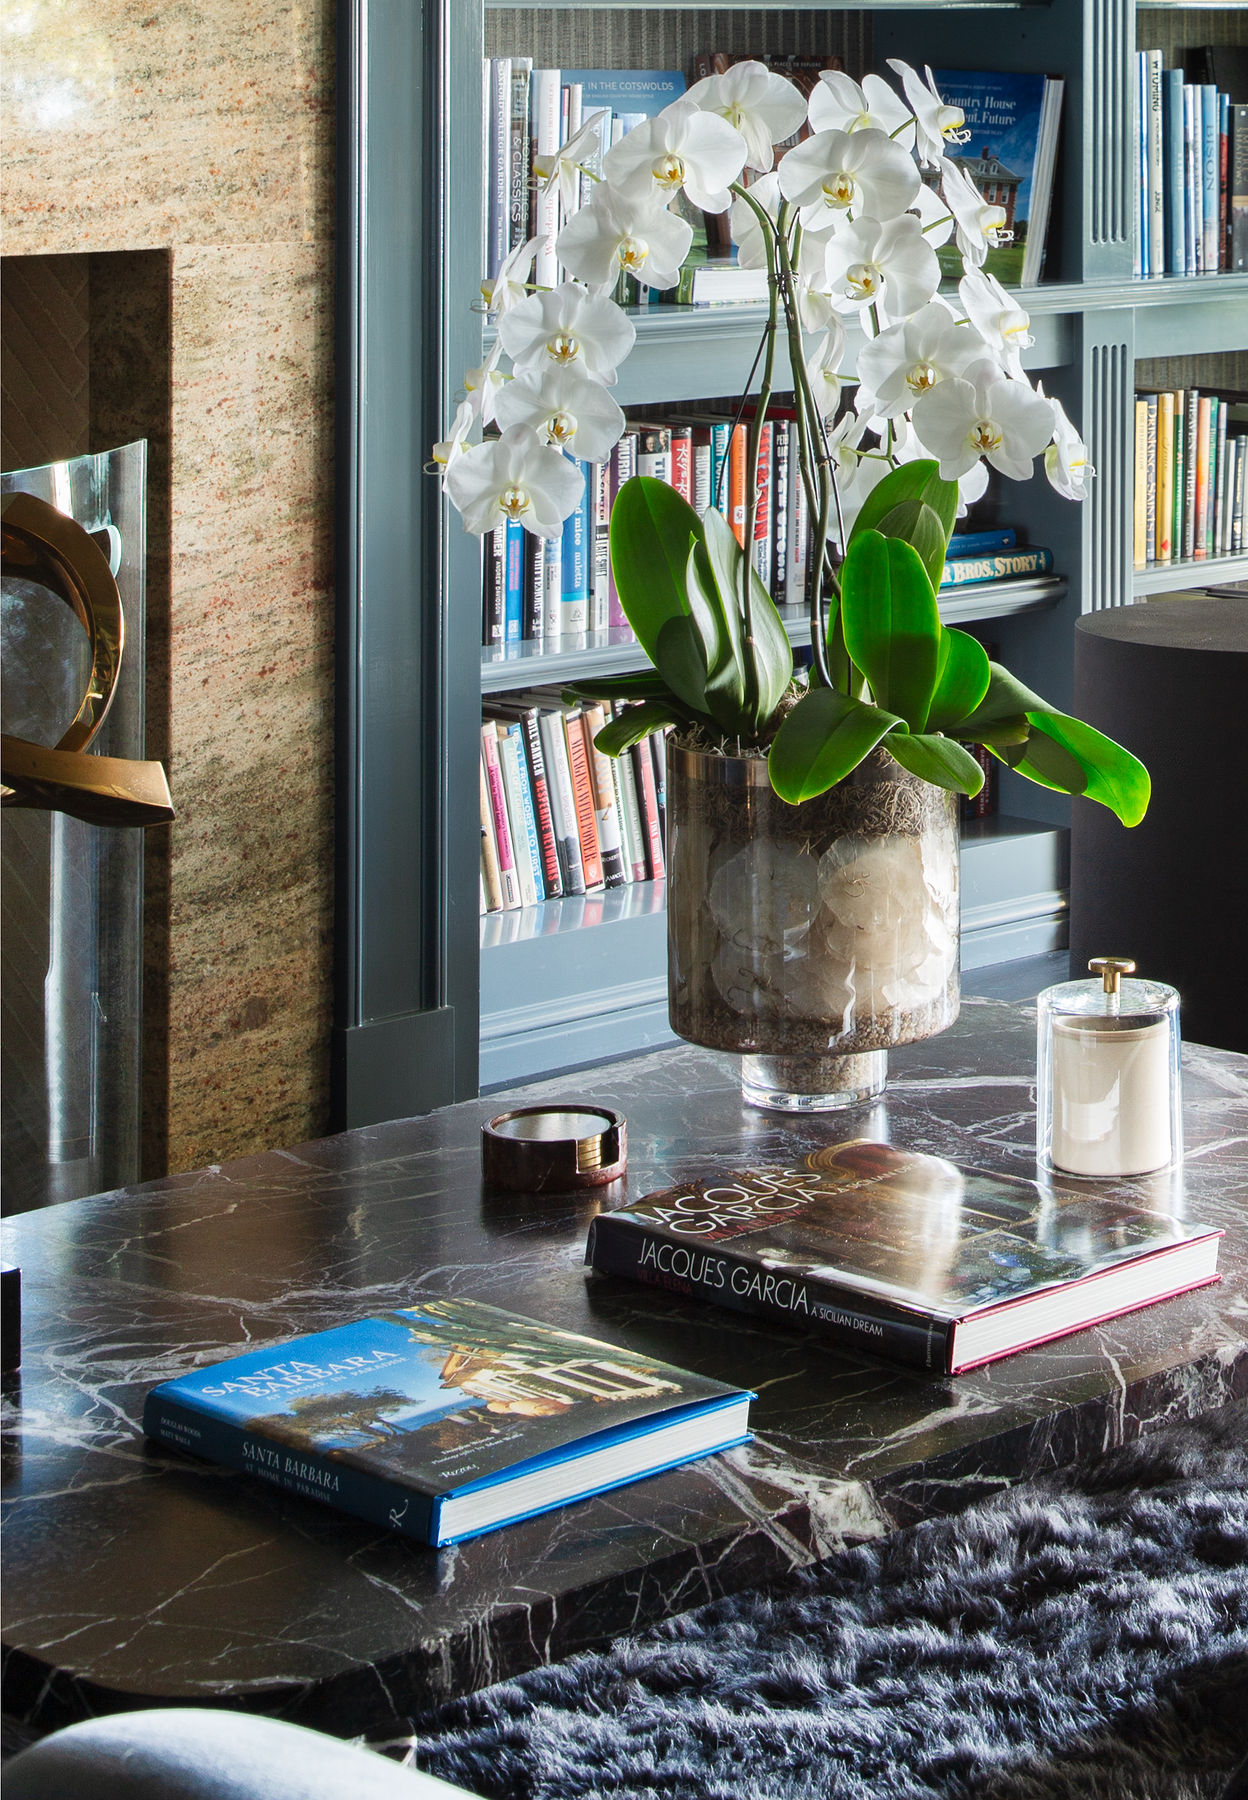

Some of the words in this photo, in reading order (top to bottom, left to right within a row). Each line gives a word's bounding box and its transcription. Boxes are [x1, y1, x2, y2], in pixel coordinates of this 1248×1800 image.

[497, 70, 505, 109] OXFORD
[588, 81, 597, 91] IN
[600, 81, 617, 91] THE
[618, 81, 674, 92] COTSWOLDS
[941, 93, 983, 112] Country
[984, 96, 1017, 110] House
[1151, 60, 1160, 112] WYOMING
[497, 111, 505, 154] COLLEGE
[982, 112, 1017, 126] Future
[1206, 125, 1215, 192] BISON
[1235, 126, 1243, 186] SHADOWS
[497, 157, 505, 204] GARDENS
[512, 150, 522, 223] CLASSICS
[715, 429, 727, 457] HIGH
[1147, 404, 1158, 474] DRINKING
[1188, 397, 1197, 450] HEAVEN
[617, 438, 631, 490] MURDO
[1146, 481, 1156, 532] SAINTS
[1186, 469, 1196, 506] HELL
[754, 484, 769, 541] RUN
[574, 551, 584, 588] auletta
[595, 541, 608, 558] LATE
[595, 558, 608, 577] SHIFT
[952, 559, 995, 583] BROS.
[994, 553, 1038, 577] STORY
[533, 551, 543, 613] WHITTEMORE
[527, 717, 539, 742] BILL
[532, 741, 544, 777] CARTER
[570, 737, 587, 792] MANAGING
[518, 766, 530, 796] FROM
[522, 797, 535, 832] WORST
[536, 778, 552, 832] DESPERATE
[577, 789, 592, 822] WITH
[581, 821, 597, 863] POWER
[648, 819, 659, 838] TINA
[529, 849, 541, 877] FIRST
[543, 832, 560, 882] NETWORKS
[650, 837, 661, 865] BROWN
[634, 1168, 822, 1225] JACQUES
[669, 1186, 838, 1234] GARCIA
[637, 1237, 727, 1289] JACQUES
[730, 1265, 809, 1315] GARCIA
[811, 1306, 818, 1317] A
[819, 1306, 851, 1328] SICILIAN
[852, 1318, 884, 1337] DREAM
[201, 1360, 318, 1398] SANTA
[242, 1349, 401, 1398] BARBARA
[242, 1440, 281, 1469] SANTA
[284, 1455, 341, 1493] BARBARA
[257, 1467, 281, 1483] HOME
[296, 1481, 331, 1503] PARADISE
